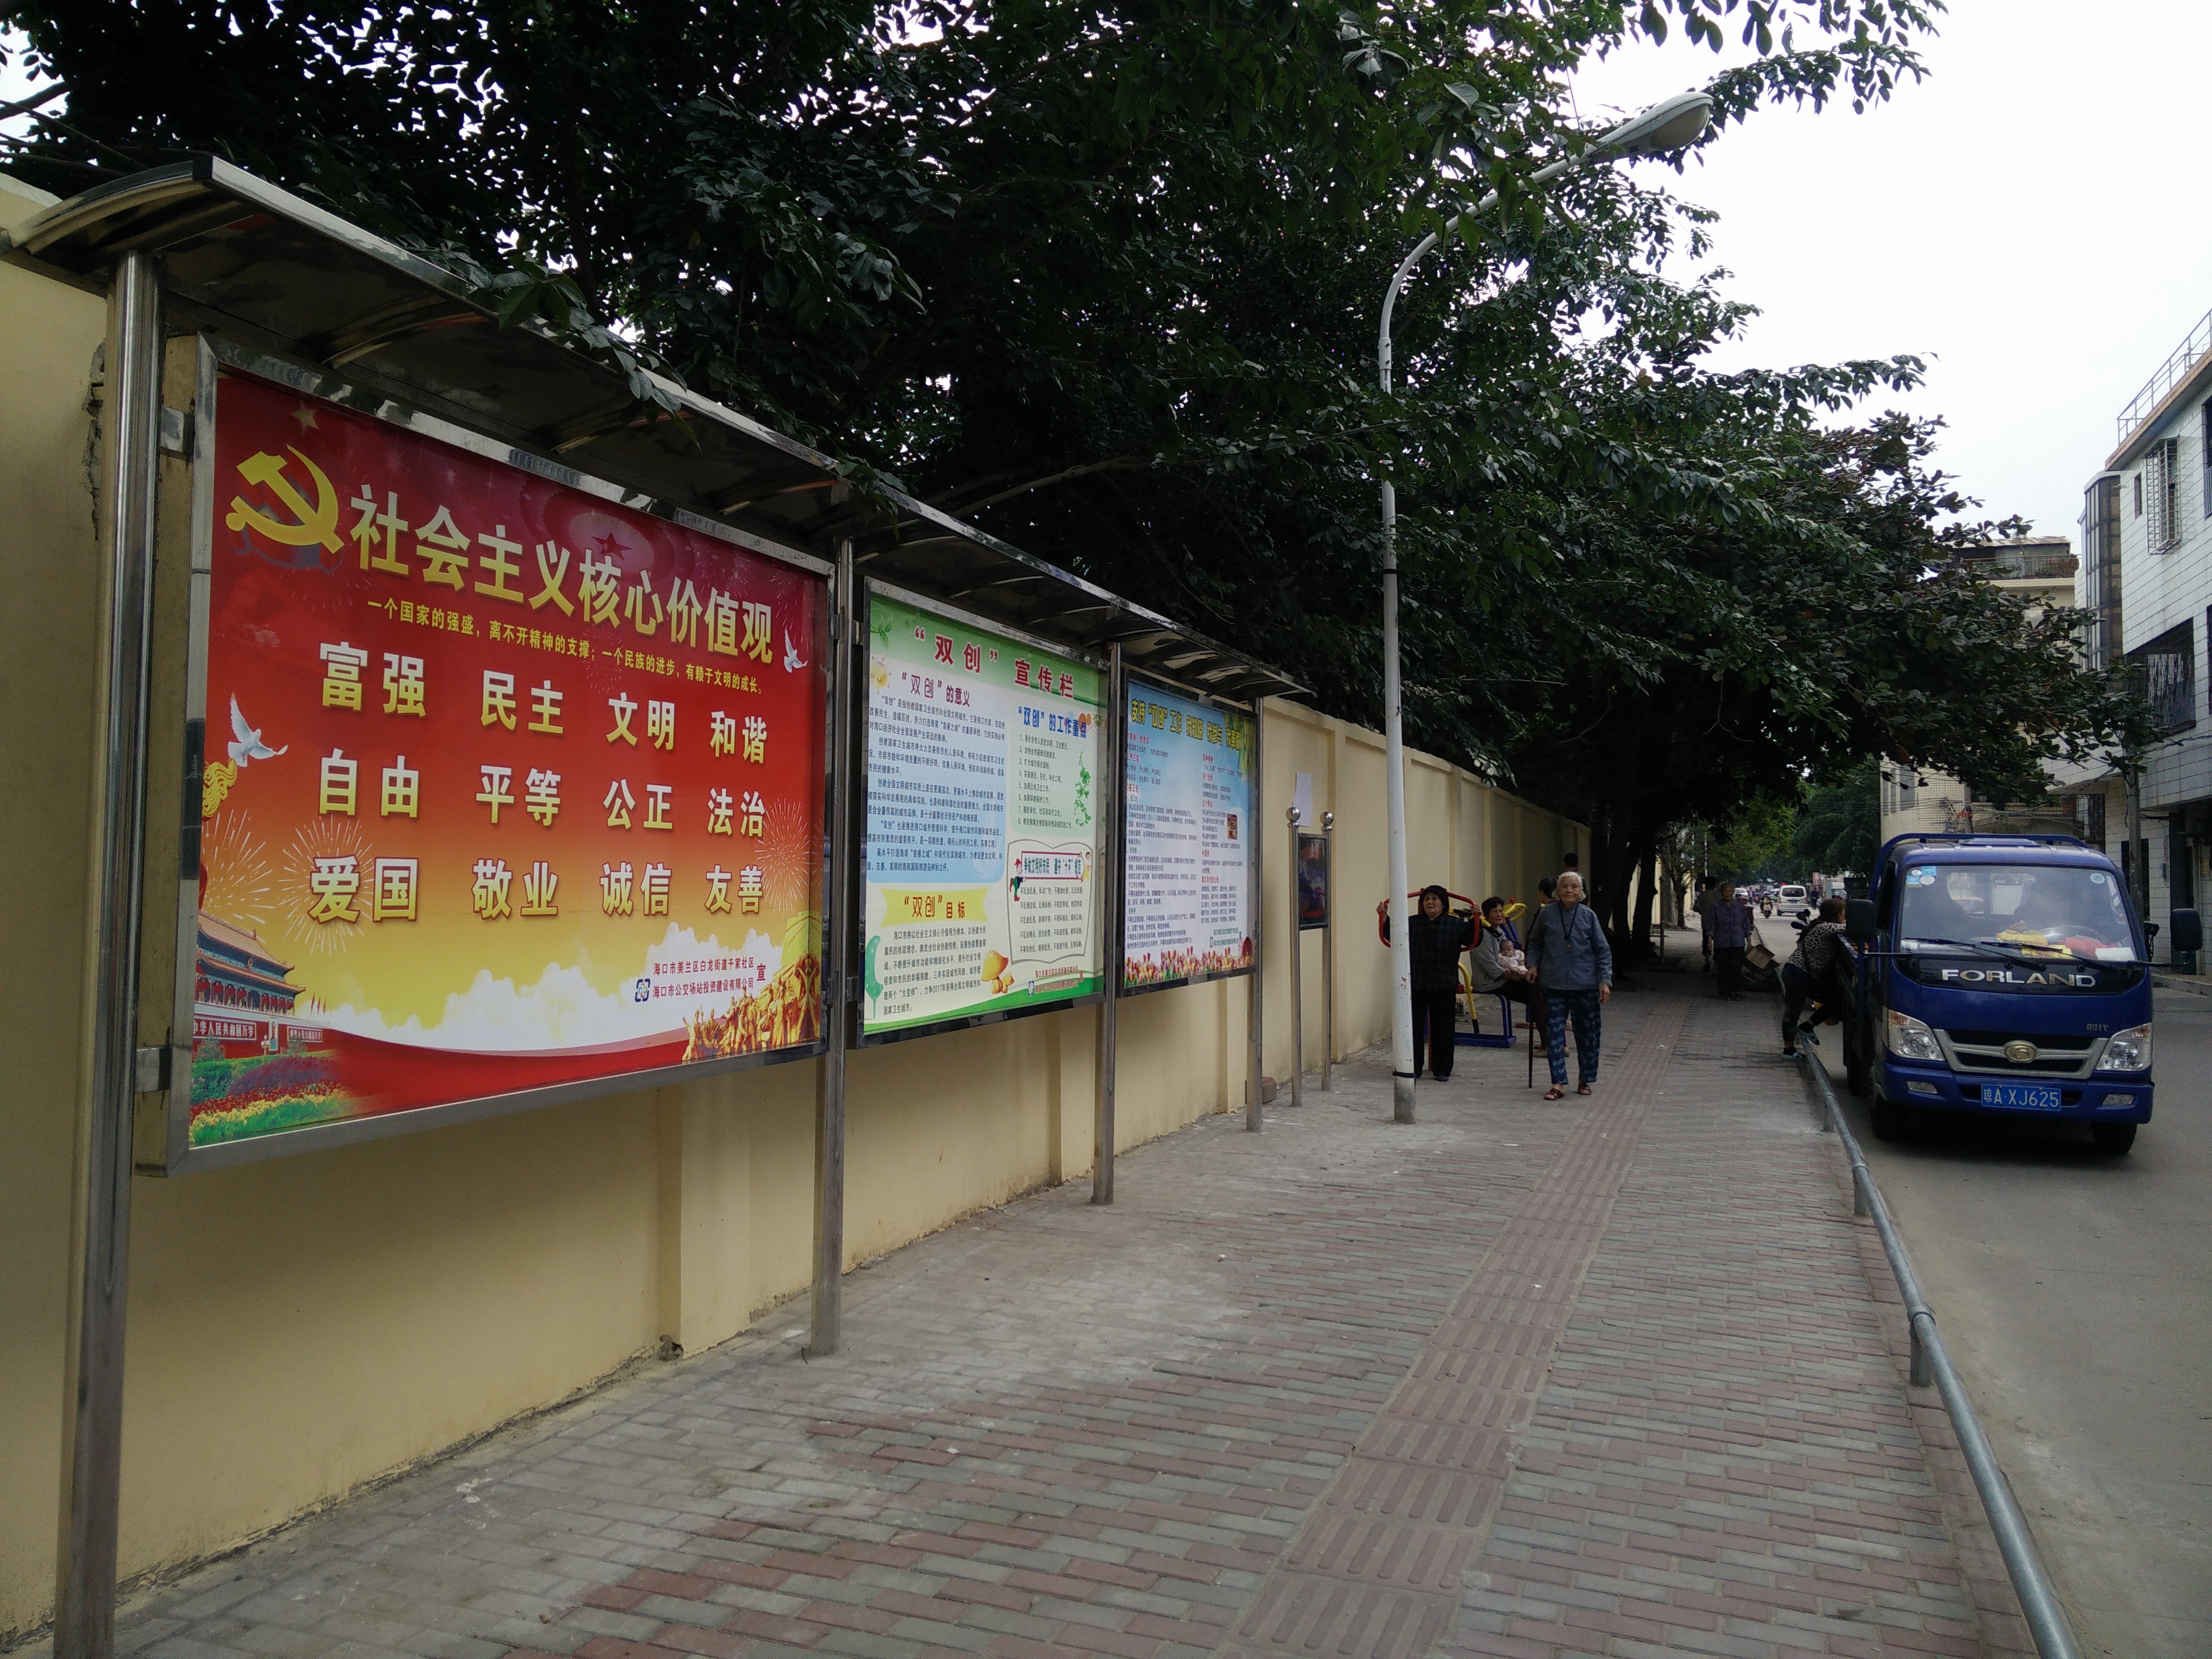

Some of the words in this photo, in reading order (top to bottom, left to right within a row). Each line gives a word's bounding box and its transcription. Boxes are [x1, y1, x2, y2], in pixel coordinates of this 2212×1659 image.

[350, 483, 774, 665] 社会主义核心价值观
[367, 597, 763, 695] 一个国家的强盛，离不开精神的支撑；一个民族的进步，有赖于文明的成长。
[319, 641, 426, 718] 富强
[480, 670, 564, 735] 民主
[606, 692, 675, 749] 文明
[709, 709, 767, 764] 和谐
[902, 672, 971, 707] “双创”的意义
[1018, 706, 1086, 739] “双创”的工作重点
[319, 747, 419, 817] 自由
[475, 765, 561, 827] 平等
[602, 778, 674, 831] 公正
[707, 786, 765, 837] 法治
[308, 854, 419, 925] 爱国
[472, 857, 559, 921] 敬业
[600, 861, 673, 917] 诚信
[706, 864, 764, 915] 友善
[904, 894, 966, 919] “双创”目标
[653, 957, 754, 976] 海口市美兰区白龙街道千家社区
[757, 963, 766, 981] 宣
[1942, 969, 2096, 987] FORLAND
[653, 977, 753, 998] 海口市公交场站投资建设有限公司
[2087, 1023, 2109, 1032] 时代
